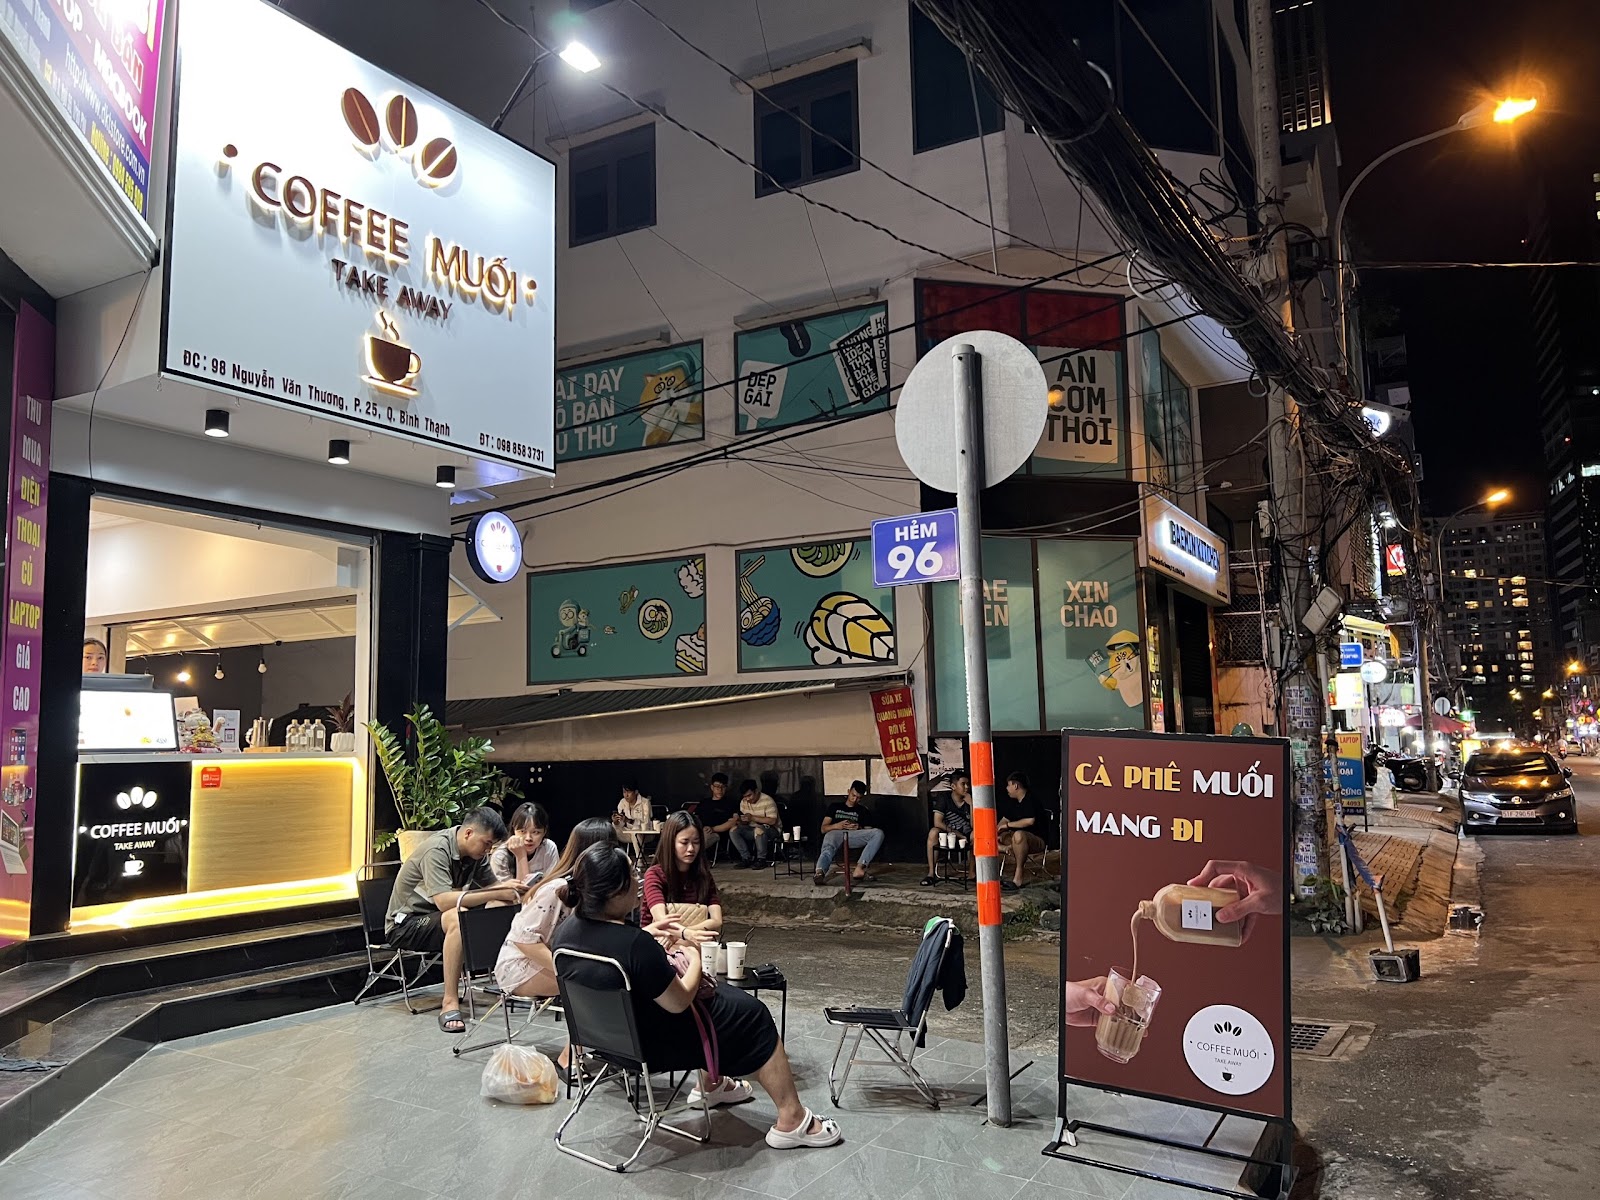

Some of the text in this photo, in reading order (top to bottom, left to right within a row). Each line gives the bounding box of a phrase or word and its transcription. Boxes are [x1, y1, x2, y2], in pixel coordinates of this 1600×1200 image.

[94, 38, 147, 147] MACBOOK
[251, 161, 517, 305] COFFEE MUỐI
[331, 258, 453, 321] TAKE AWAY
[845, 341, 871, 363] IDEA
[849, 348, 875, 371] THAY
[211, 357, 226, 376] 98
[232, 363, 275, 390] Nguyễn
[282, 377, 302, 397] Văn
[399, 410, 420, 429] Bình
[424, 416, 451, 439] Thạnh
[556, 366, 625, 403] ẠI ĐÂY
[27, 395, 42, 426] THU
[573, 395, 615, 426] BÁN
[1050, 384, 1106, 415] CƠM
[1047, 415, 1113, 446] THÔI
[22, 434, 42, 467] MUA
[21, 475, 40, 509] ĐIỆN
[17, 516, 41, 552] THOẠI
[894, 519, 938, 542] HẺM
[887, 541, 943, 580] 96
[959, 579, 1008, 602] AE
[1066, 580, 1109, 603] XIN
[10, 599, 40, 629] LAPTOP
[959, 604, 1009, 627] IN
[1060, 605, 1118, 628] CHÀO
[16, 641, 31, 669] GIÁ
[13, 686, 30, 712] CAO
[881, 693, 902, 705] SỬA XE
[876, 709, 897, 722] QUANG
[889, 736, 911, 753] 163
[1340, 736, 1358, 744] LAPTOP
[1074, 755, 1274, 798] CÀ PHÊ MUỐI
[90, 816, 180, 840] COFFEE MUỐI
[1075, 809, 1203, 843] MANG ĐI
[114, 840, 156, 851] TAKE AWAY
[1196, 1041, 1260, 1060] COFFEE MUỐI
[1214, 1057, 1227, 1065] TAKE
